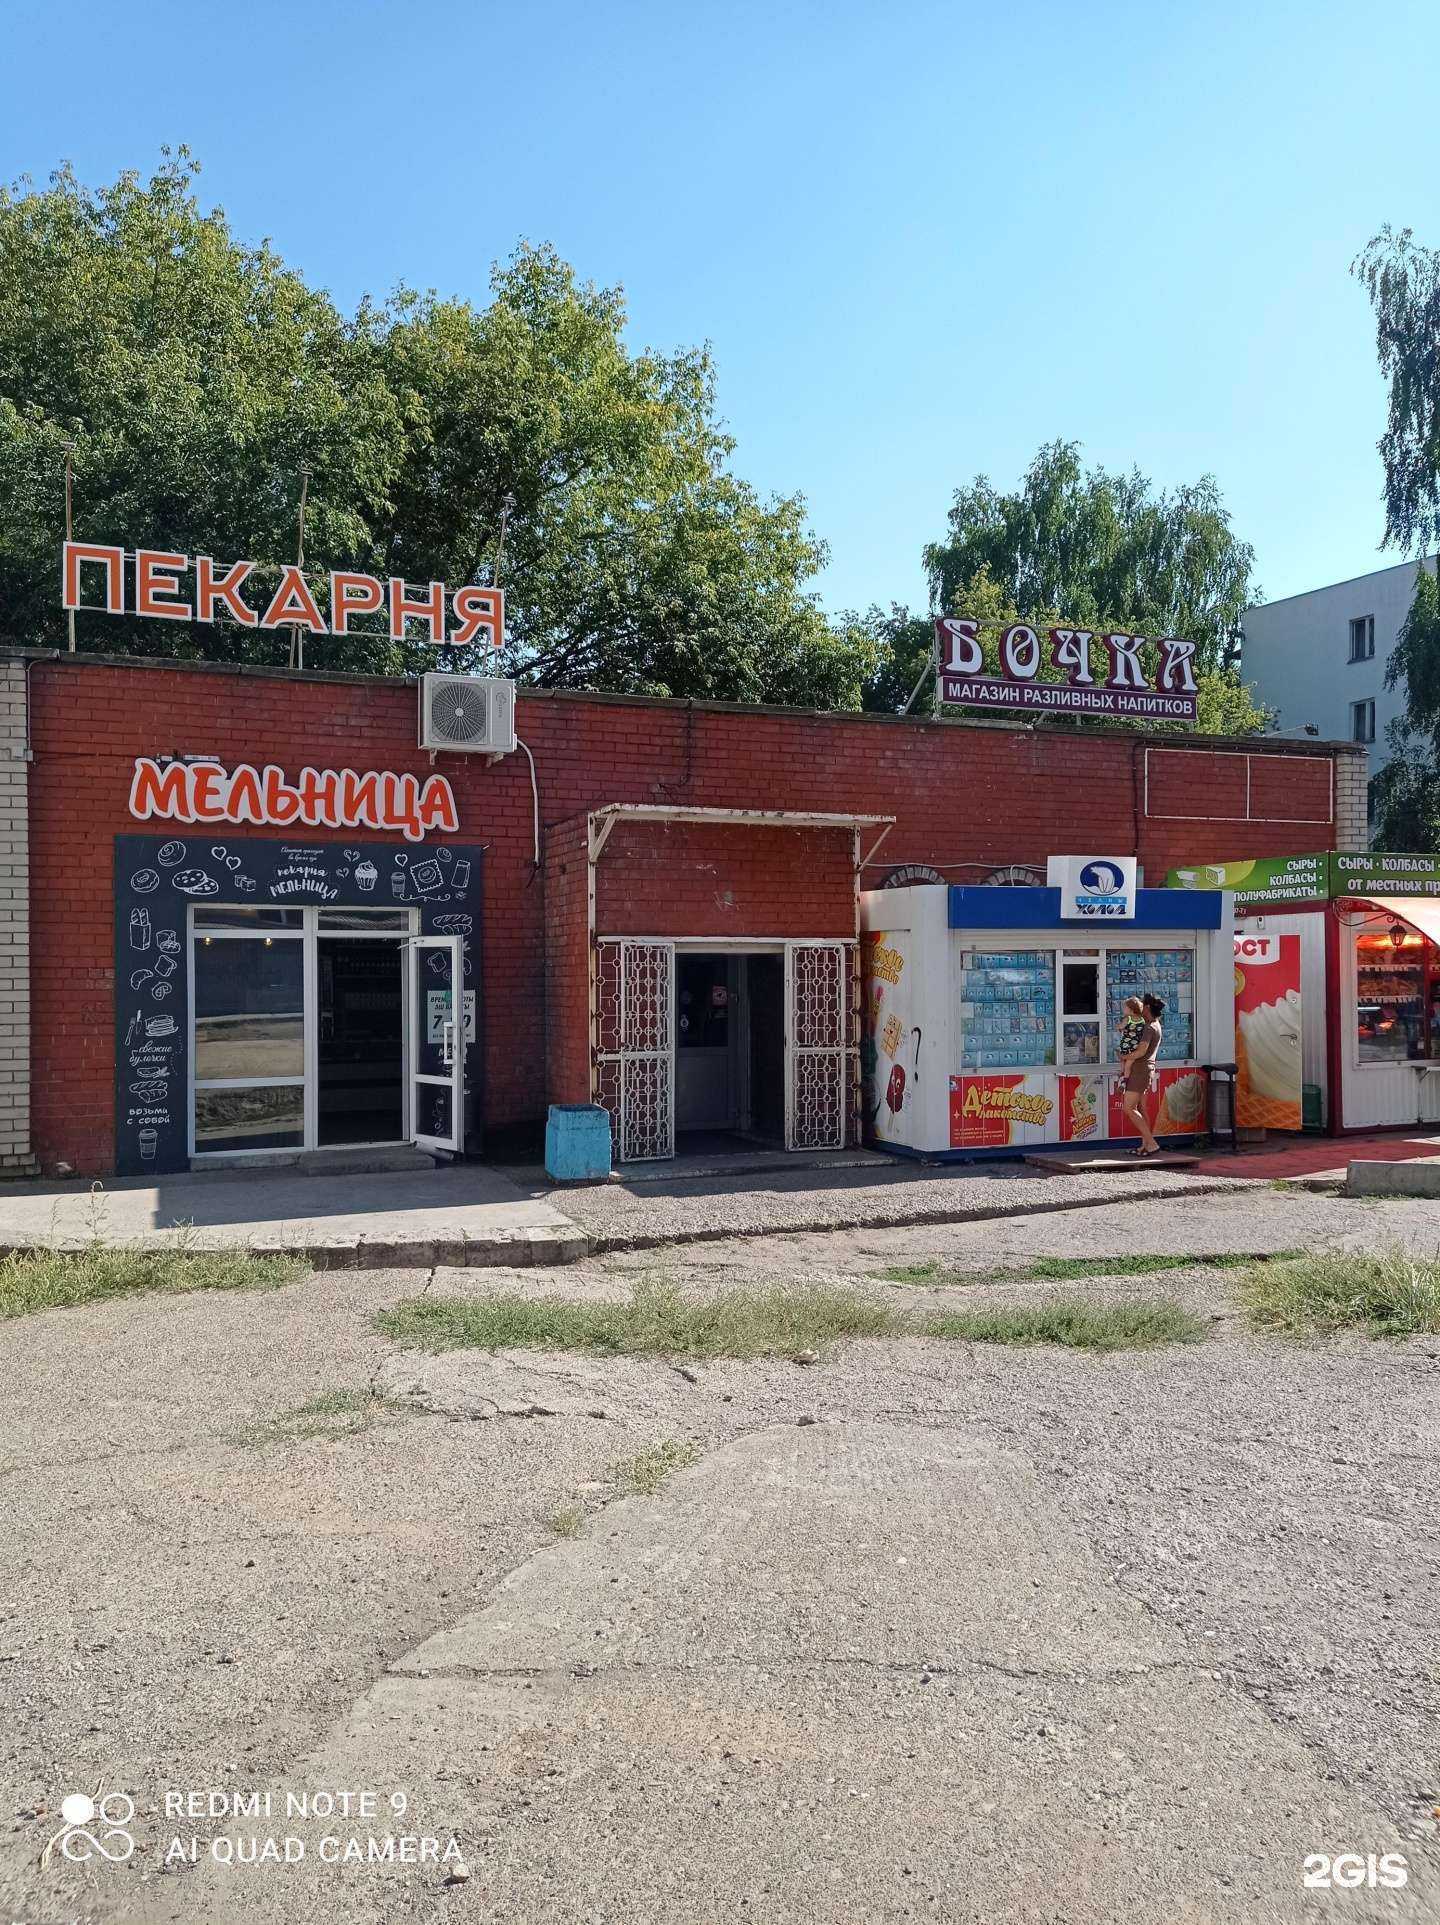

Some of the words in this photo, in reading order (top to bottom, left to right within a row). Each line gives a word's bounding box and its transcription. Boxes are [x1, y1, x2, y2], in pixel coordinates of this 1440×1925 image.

[62, 541, 505, 648] ПЕКАРНЯ
[938, 617, 1200, 692] БОЧКА
[948, 682, 1020, 703] МАГАЗИН
[1023, 687, 1115, 710] РАЗЛИВНЫХ
[1117, 695, 1193, 715] НАПИТКОВ
[129, 758, 460, 842] МЕЛЬНИЦА
[1286, 859, 1317, 871] СЫРЫ
[1337, 856, 1374, 871] СЫРЫ
[1382, 858, 1435, 872] КОЛБАСЫ
[269, 878, 338, 900] МЕЛЬНИЦА
[1269, 872, 1317, 886] КОЛБАСЫ
[1365, 879, 1422, 892] местных
[1234, 886, 1317, 901] ПОЛУФАБРИКАТЫ
[962, 1084, 1054, 1117] Детское
